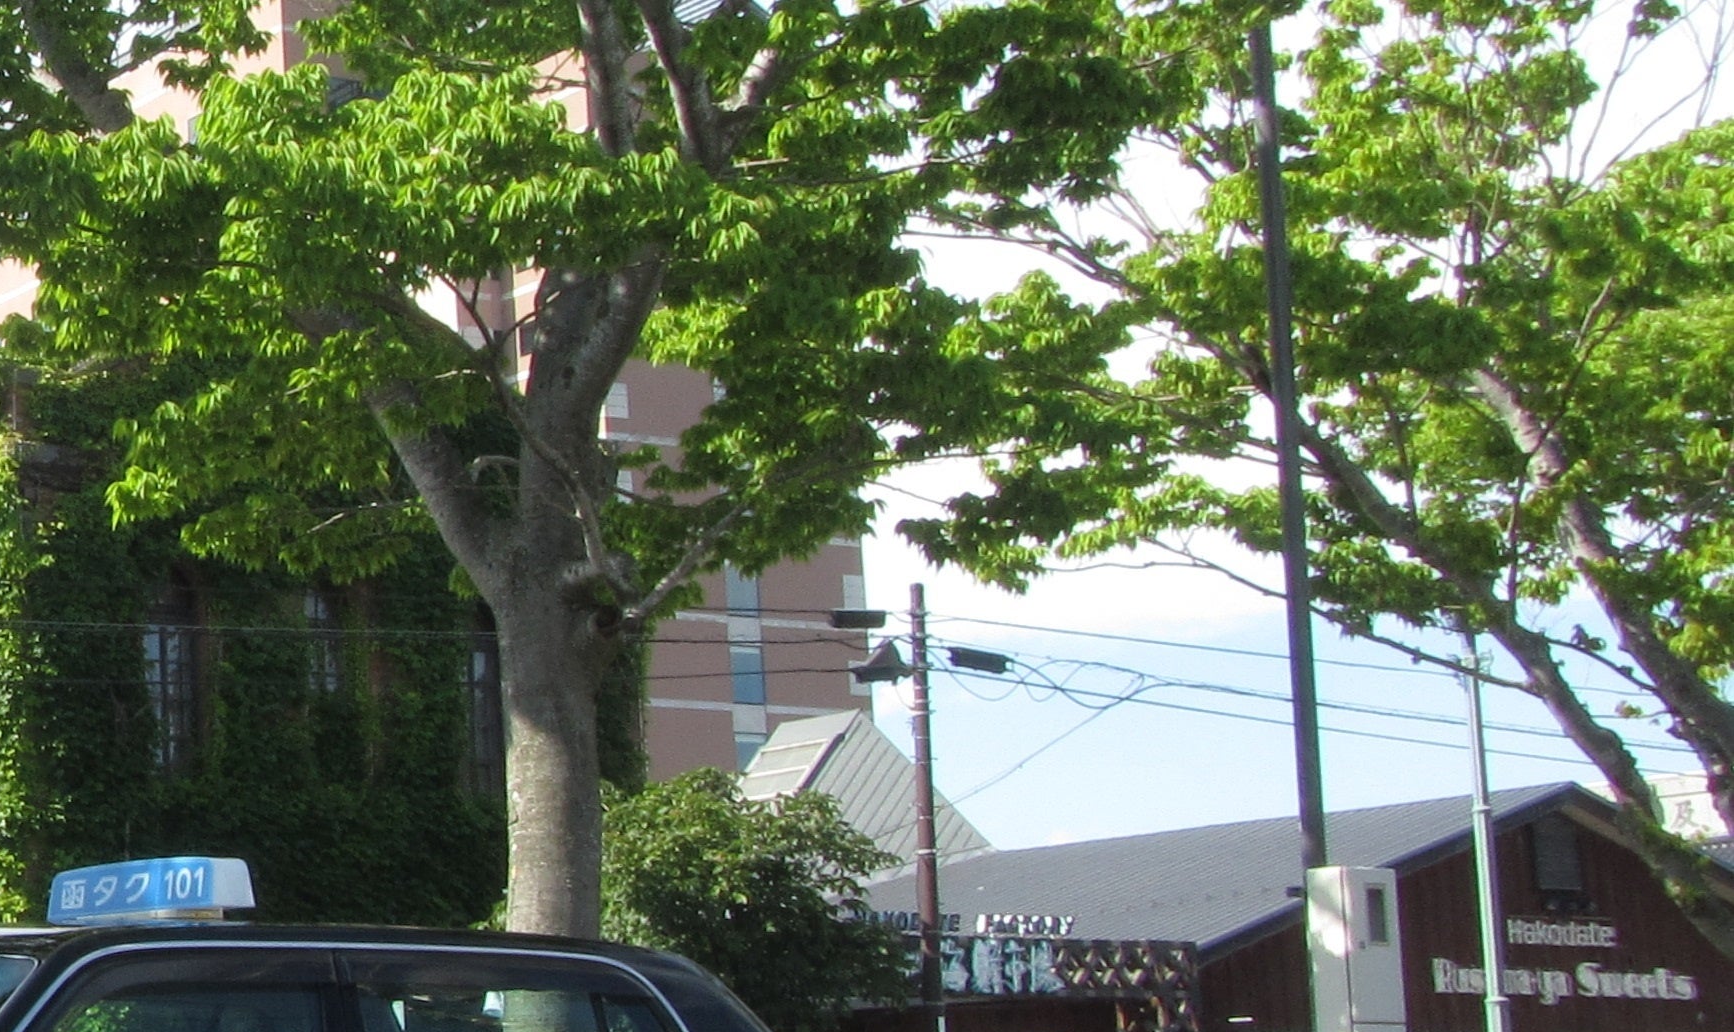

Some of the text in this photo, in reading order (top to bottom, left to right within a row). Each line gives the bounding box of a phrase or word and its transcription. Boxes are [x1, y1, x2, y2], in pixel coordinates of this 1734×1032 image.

[164, 866, 204, 900] 101
[1506, 918, 1617, 947] Hakodate
[1575, 962, 1698, 1000] Sweets
